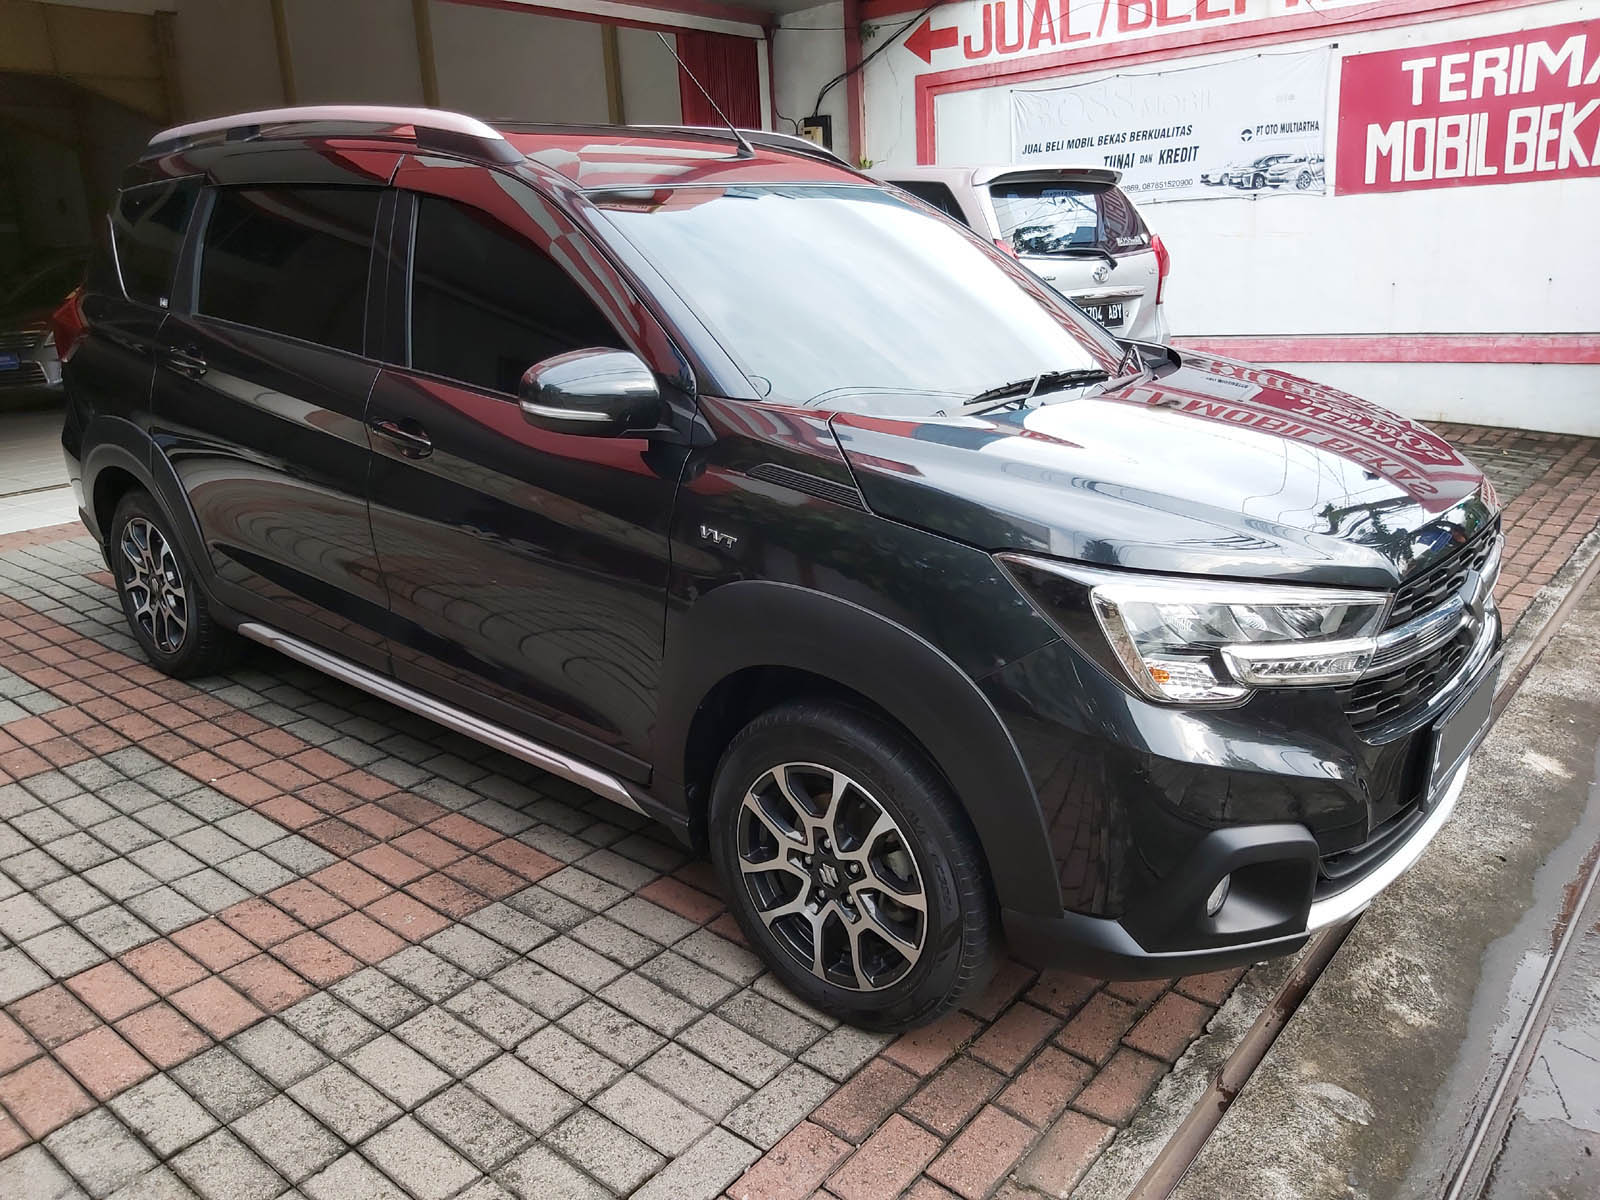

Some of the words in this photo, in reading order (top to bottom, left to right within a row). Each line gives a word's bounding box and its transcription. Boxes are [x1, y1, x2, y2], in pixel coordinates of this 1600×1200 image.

[1256, 125, 1264, 136] PT
[1265, 123, 1278, 135] OTO
[1280, 120, 1320, 134] MULTIARTHA
[1022, 143, 1043, 155] JUAL
[1045, 140, 1064, 152] BELI
[1066, 136, 1095, 149] MOBIL
[1097, 132, 1127, 146] BEKAS
[1129, 124, 1193, 142] BERKUALITAS
[1364, 112, 1498, 184] MOBIL
[1504, 98, 1600, 174] BEK
[1140, 153, 1153, 164] DAN
[1158, 145, 1200, 165] KREDIT
[1108, 303, 1122, 320] ABY
[700, 525, 738, 549] VVT
